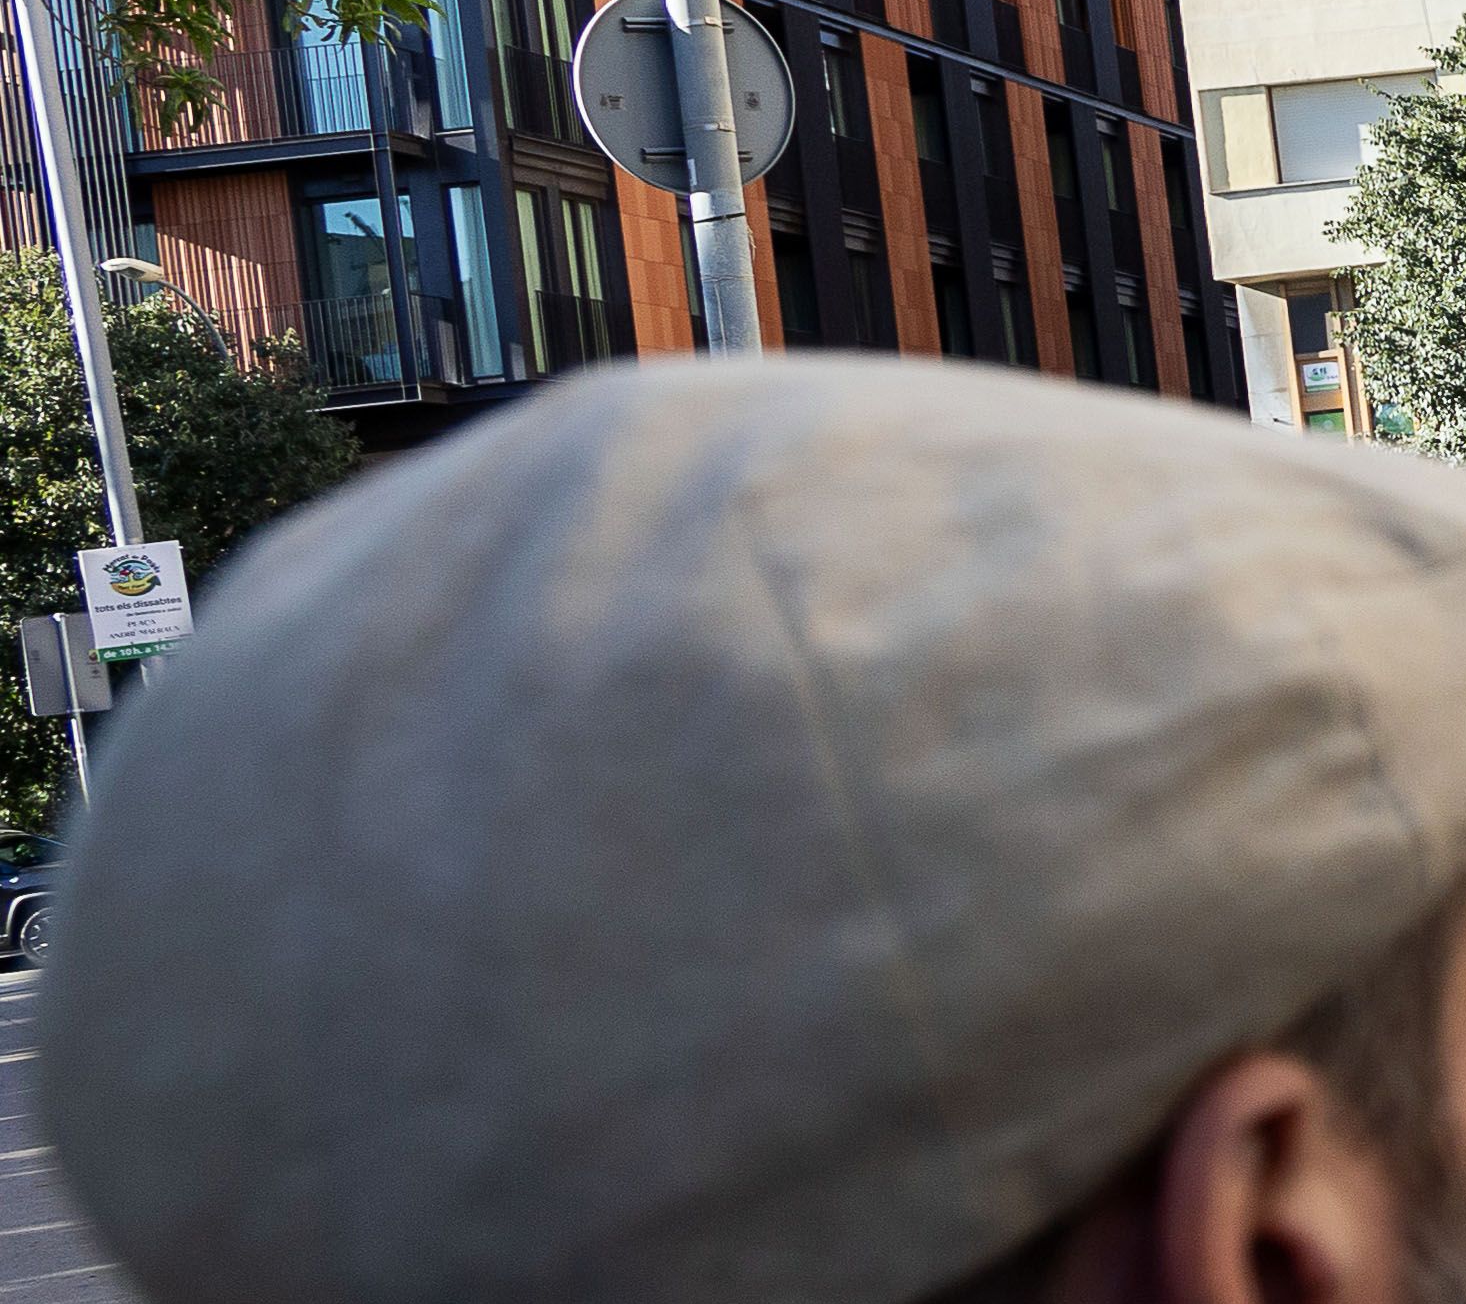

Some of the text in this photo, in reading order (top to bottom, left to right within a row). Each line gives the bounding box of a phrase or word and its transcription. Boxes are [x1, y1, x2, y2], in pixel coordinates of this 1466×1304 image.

[95, 603, 115, 613] tots
[117, 601, 131, 610] els
[133, 597, 182, 608] dissabtes
[103, 650, 117, 658] de
